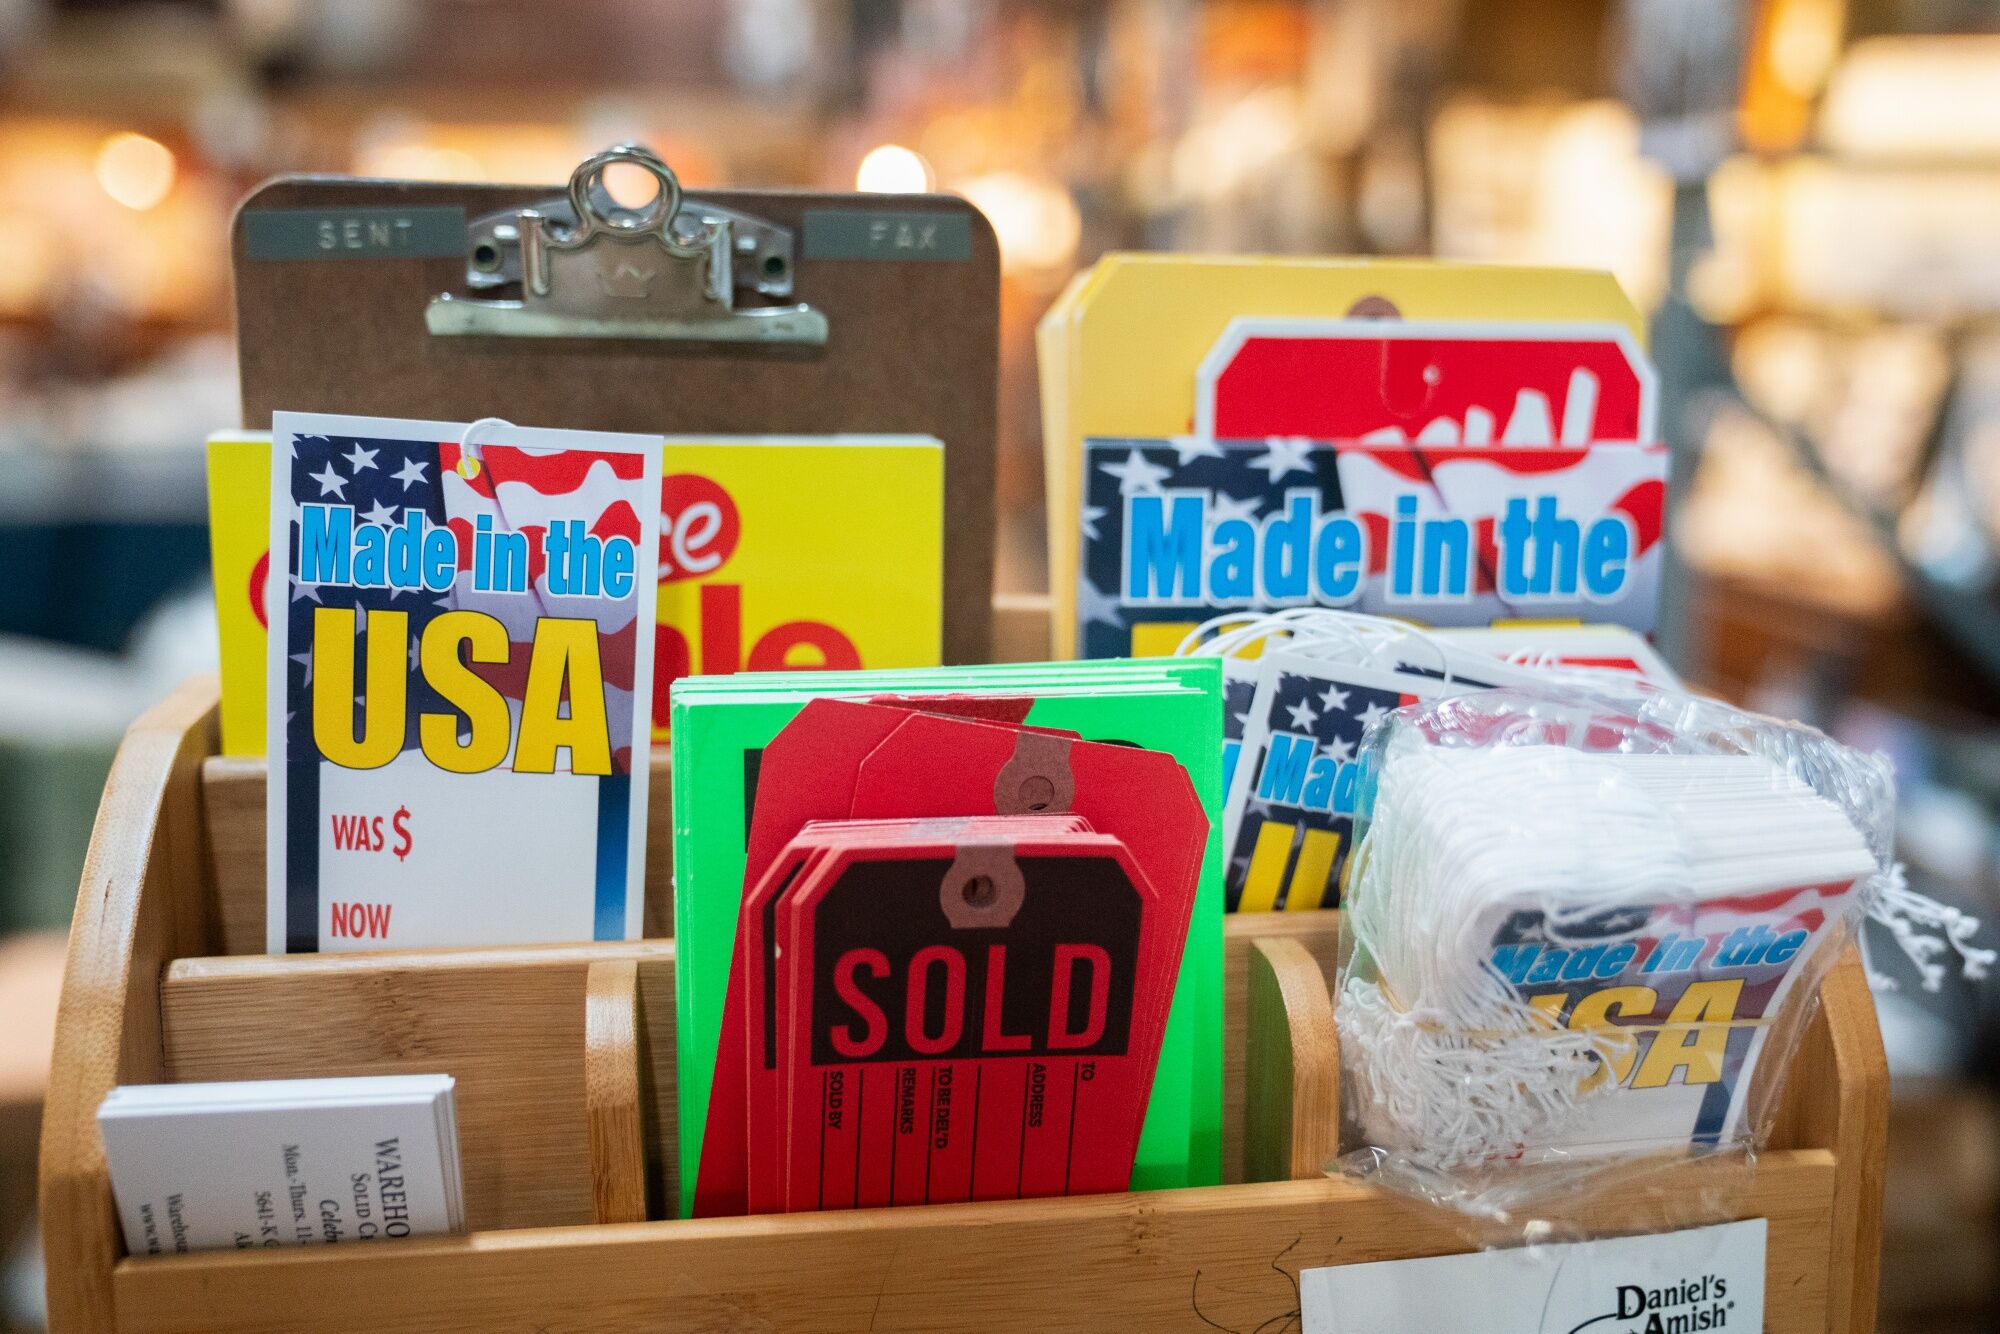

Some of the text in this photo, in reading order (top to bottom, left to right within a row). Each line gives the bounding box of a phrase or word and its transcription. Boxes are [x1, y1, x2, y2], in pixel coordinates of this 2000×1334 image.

[316, 218, 412, 248] SENT
[870, 221, 937, 250] FAX
[300, 503, 636, 599] Made in the
[1126, 492, 1632, 602] Made in the
[312, 607, 613, 776] USA
[331, 804, 413, 863] WAS $
[331, 902, 392, 939] NOW
[1641, 932, 1707, 973] in
[1711, 923, 1809, 969] the
[829, 943, 1113, 1059] SOLD
[828, 1071, 843, 1130] SOLD BY
[900, 1067, 916, 1135] REMARKS
[1029, 1063, 1046, 1128] ADDRESS
[1081, 1062, 1095, 1082] TO
[935, 1065, 952, 1149] TO BE DEL'D
[375, 1136, 410, 1238] WAREHO
[1616, 1274, 1727, 1320] Daniel's
